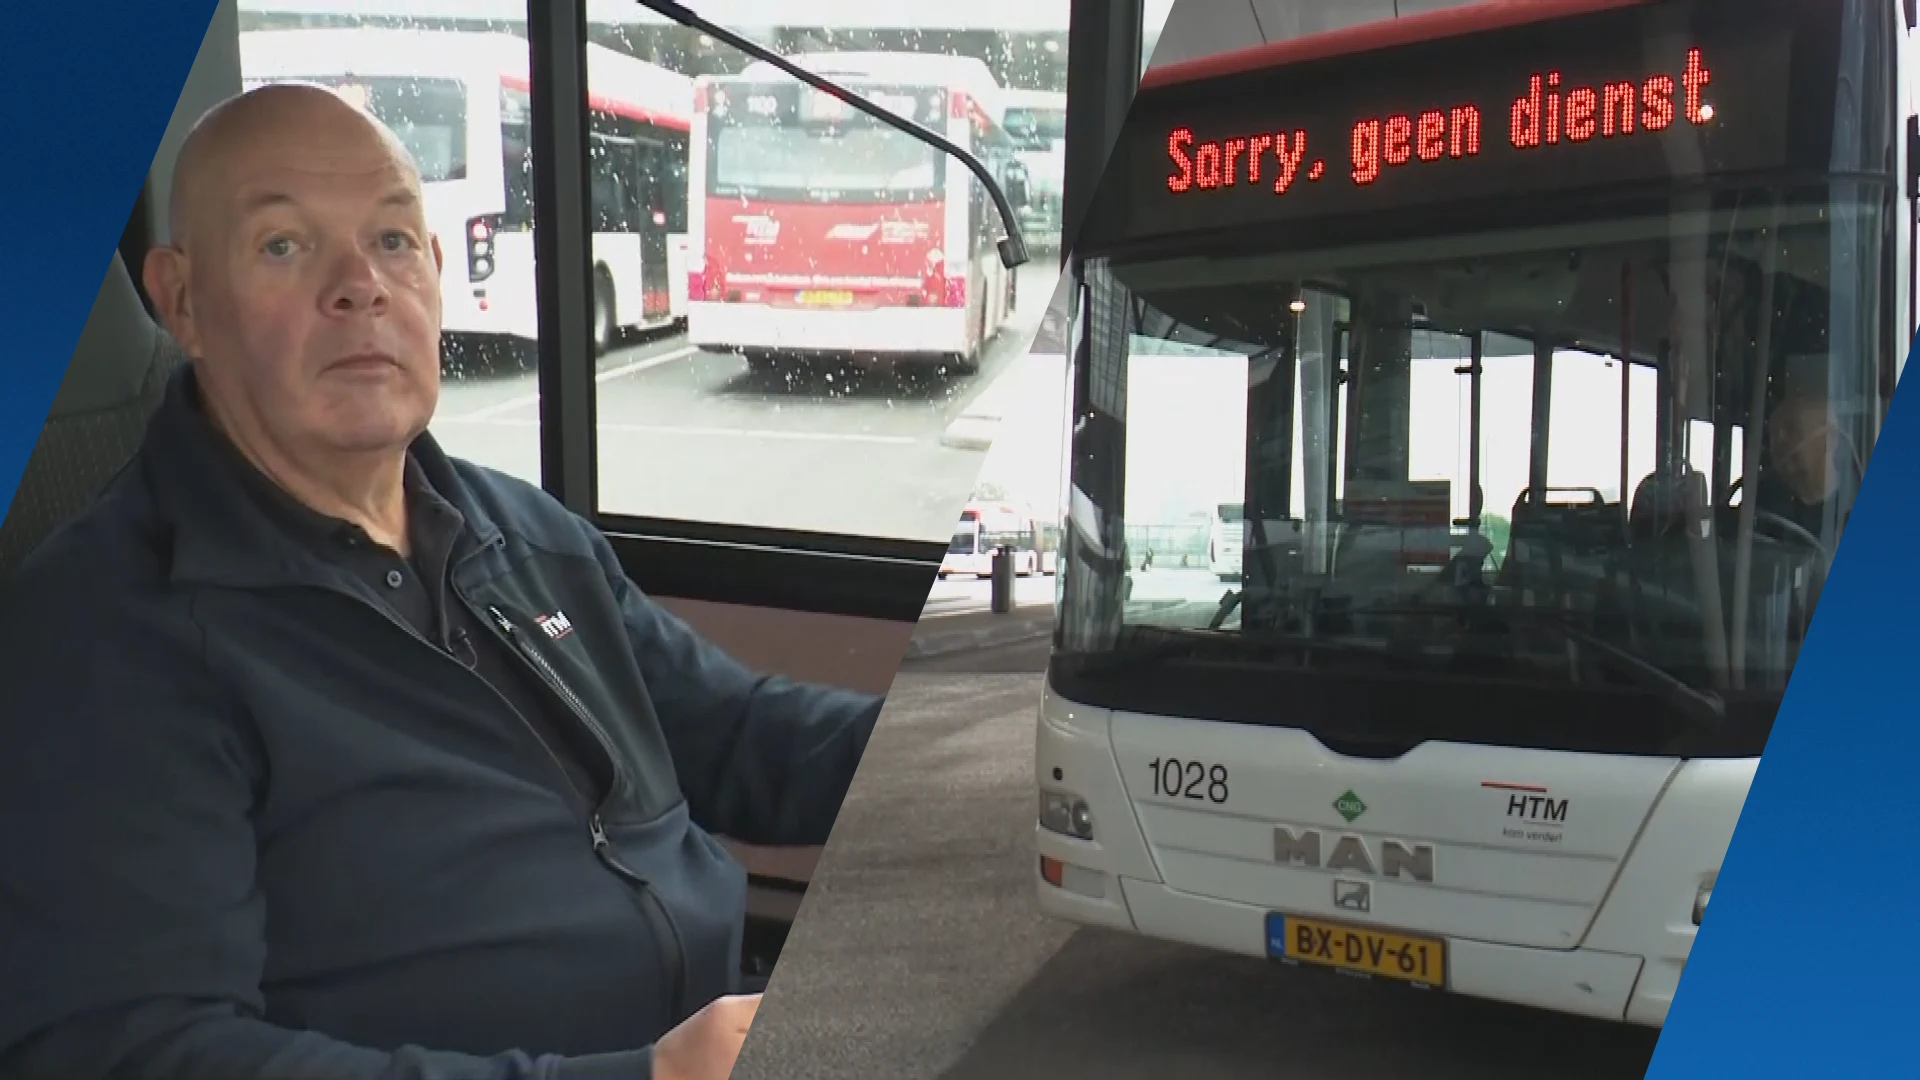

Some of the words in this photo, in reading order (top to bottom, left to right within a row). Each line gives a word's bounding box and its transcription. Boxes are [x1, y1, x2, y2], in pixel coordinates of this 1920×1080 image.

[1168, 128, 1324, 194] Sorry,
[1351, 104, 1481, 184] geen
[1509, 46, 1710, 149] dienst
[1148, 757, 1229, 804] 1028
[1506, 793, 1569, 822] HTM
[1273, 824, 1434, 883] MAN
[1297, 923, 1428, 977] BX-DV-61
